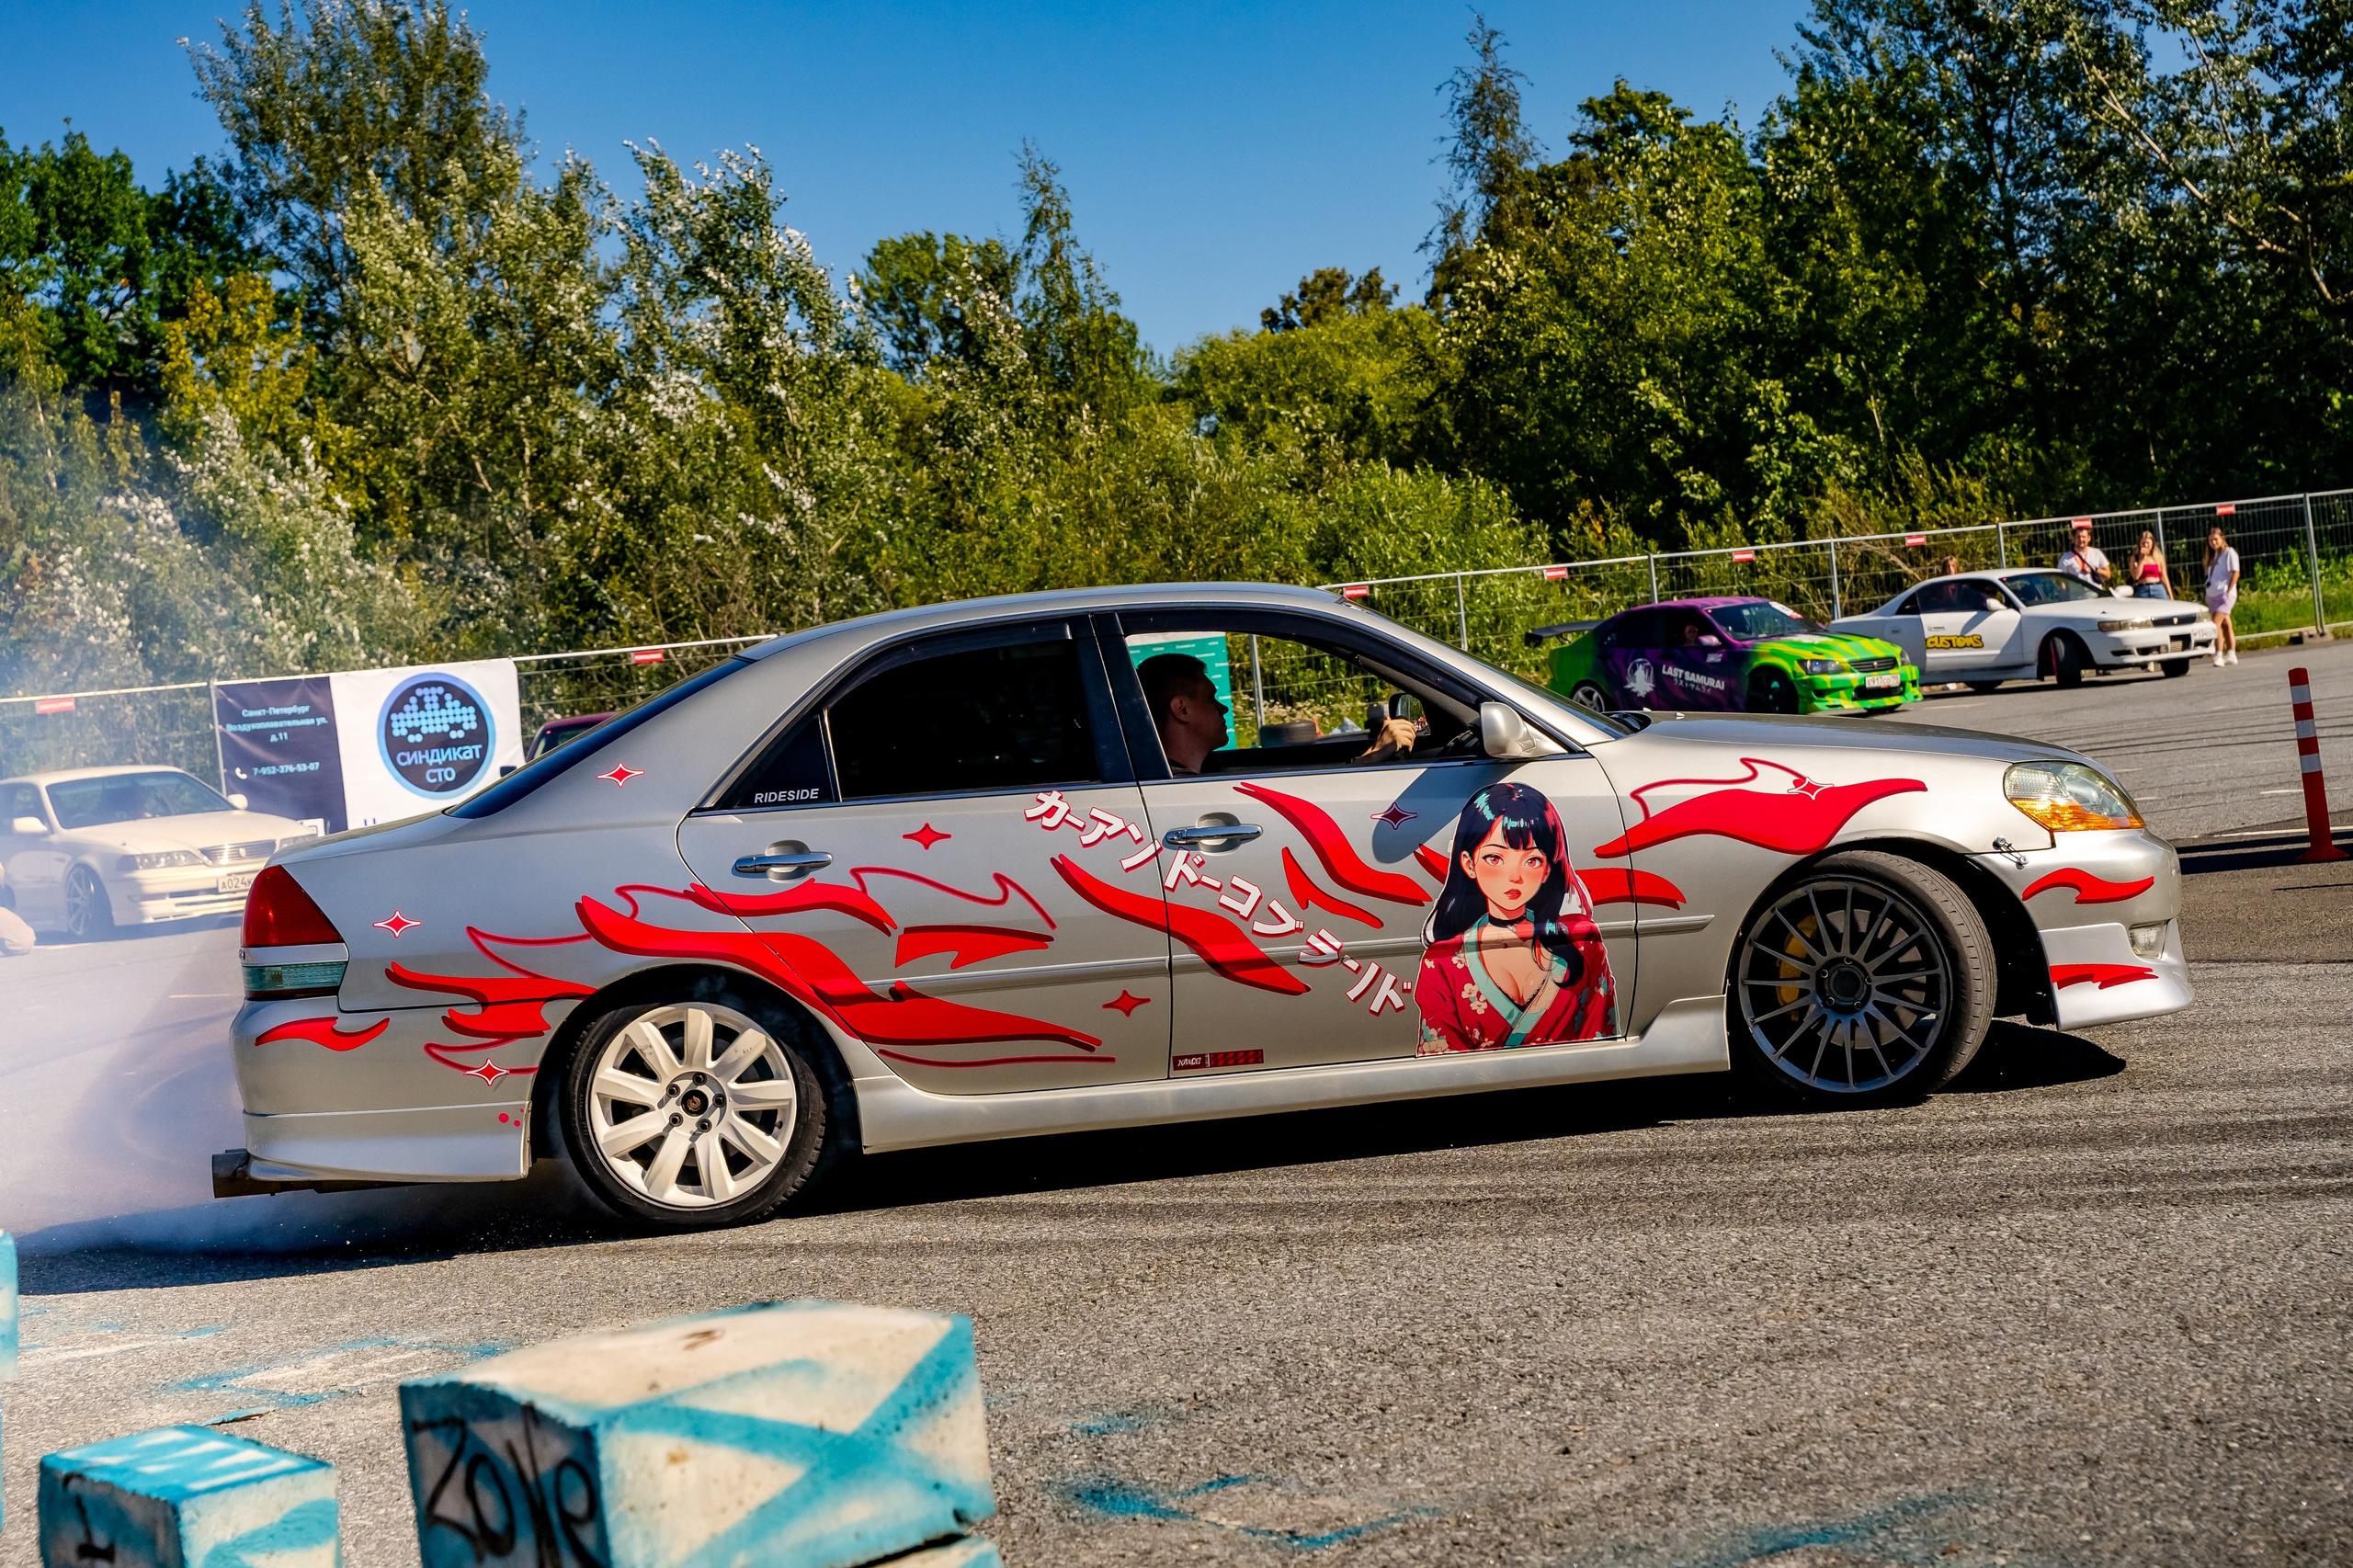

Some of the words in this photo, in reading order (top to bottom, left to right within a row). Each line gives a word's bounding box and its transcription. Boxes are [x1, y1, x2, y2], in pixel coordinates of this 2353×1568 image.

[1926, 634, 1984, 649] CUSTOMS
[1662, 664, 1687, 678] LAST
[1684, 671, 1725, 690] SAMURAI
[242, 704, 311, 717] Санкт-Петербург
[754, 788, 820, 804] RIDESIDE
